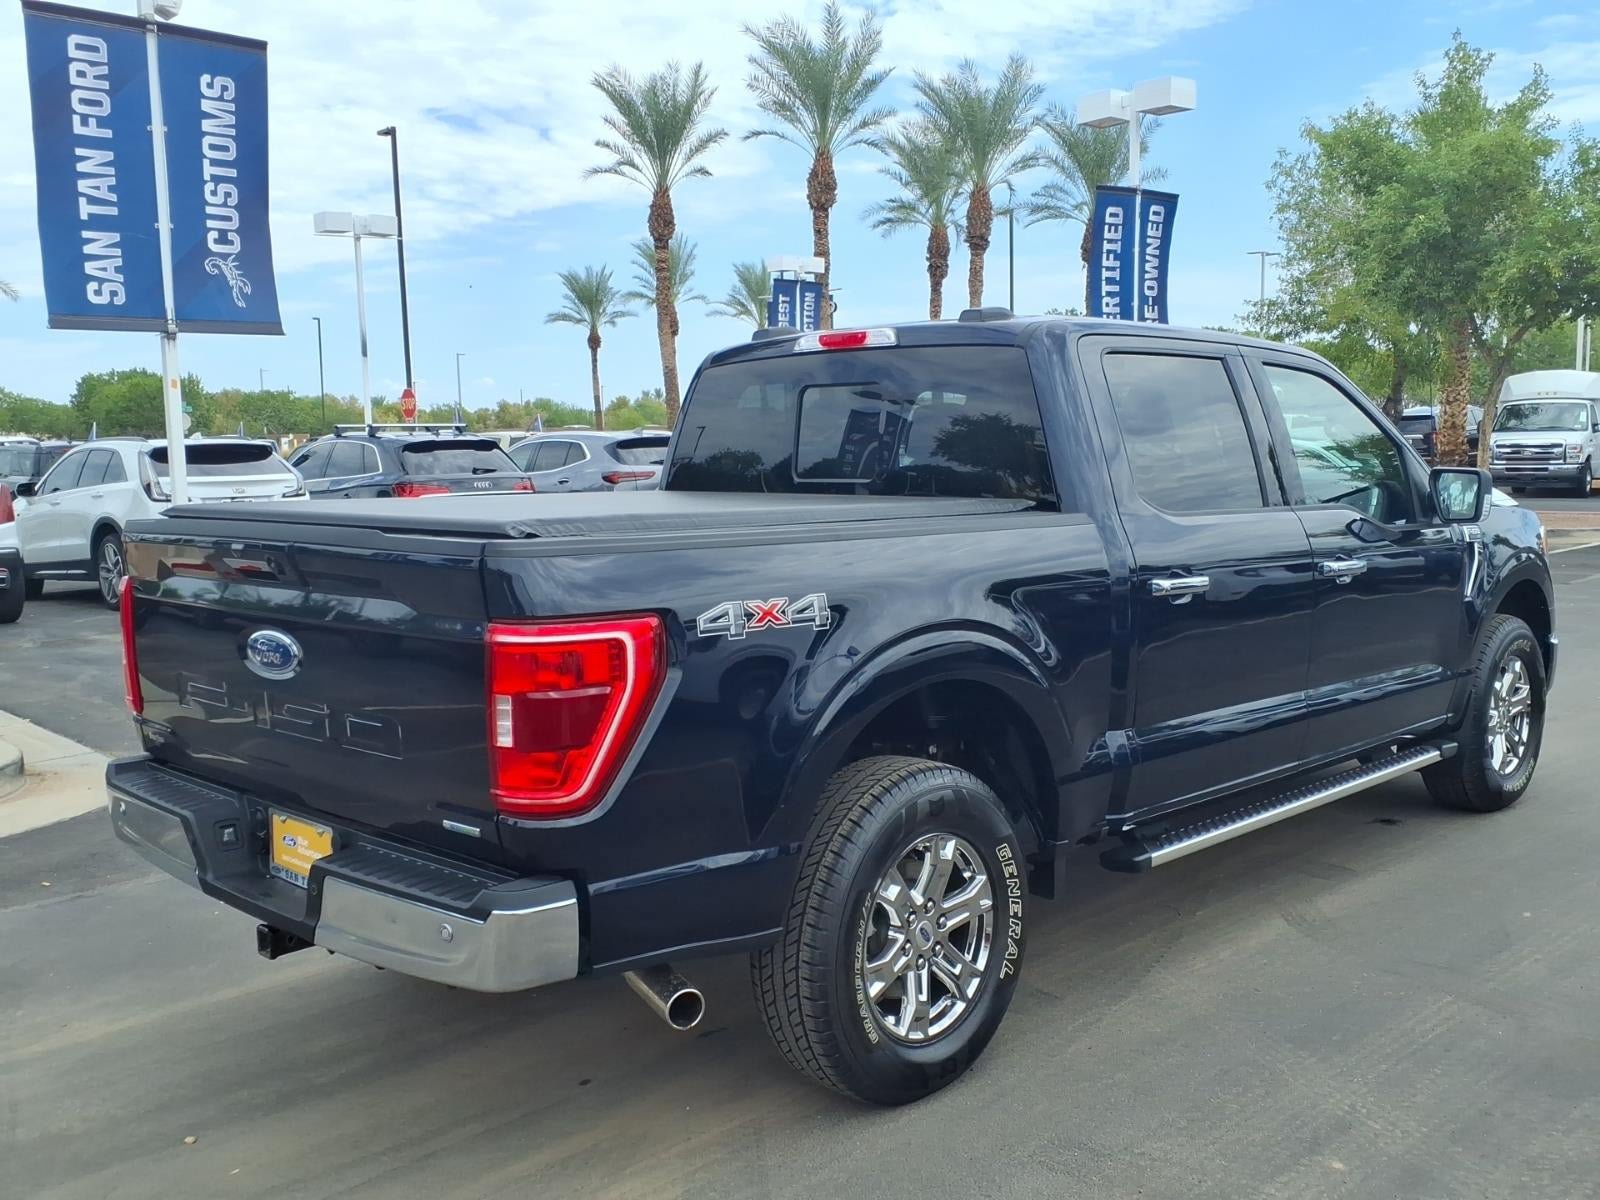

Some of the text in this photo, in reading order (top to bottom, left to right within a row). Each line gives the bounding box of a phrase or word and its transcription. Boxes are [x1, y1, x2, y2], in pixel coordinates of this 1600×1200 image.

[67, 33, 126, 305] SAN TAN FORD
[200, 73, 241, 254] CUSTOMS
[1144, 204, 1165, 323] E-OWNED
[401, 398, 416, 410] STOP
[996, 843, 1022, 979] GENERAL
